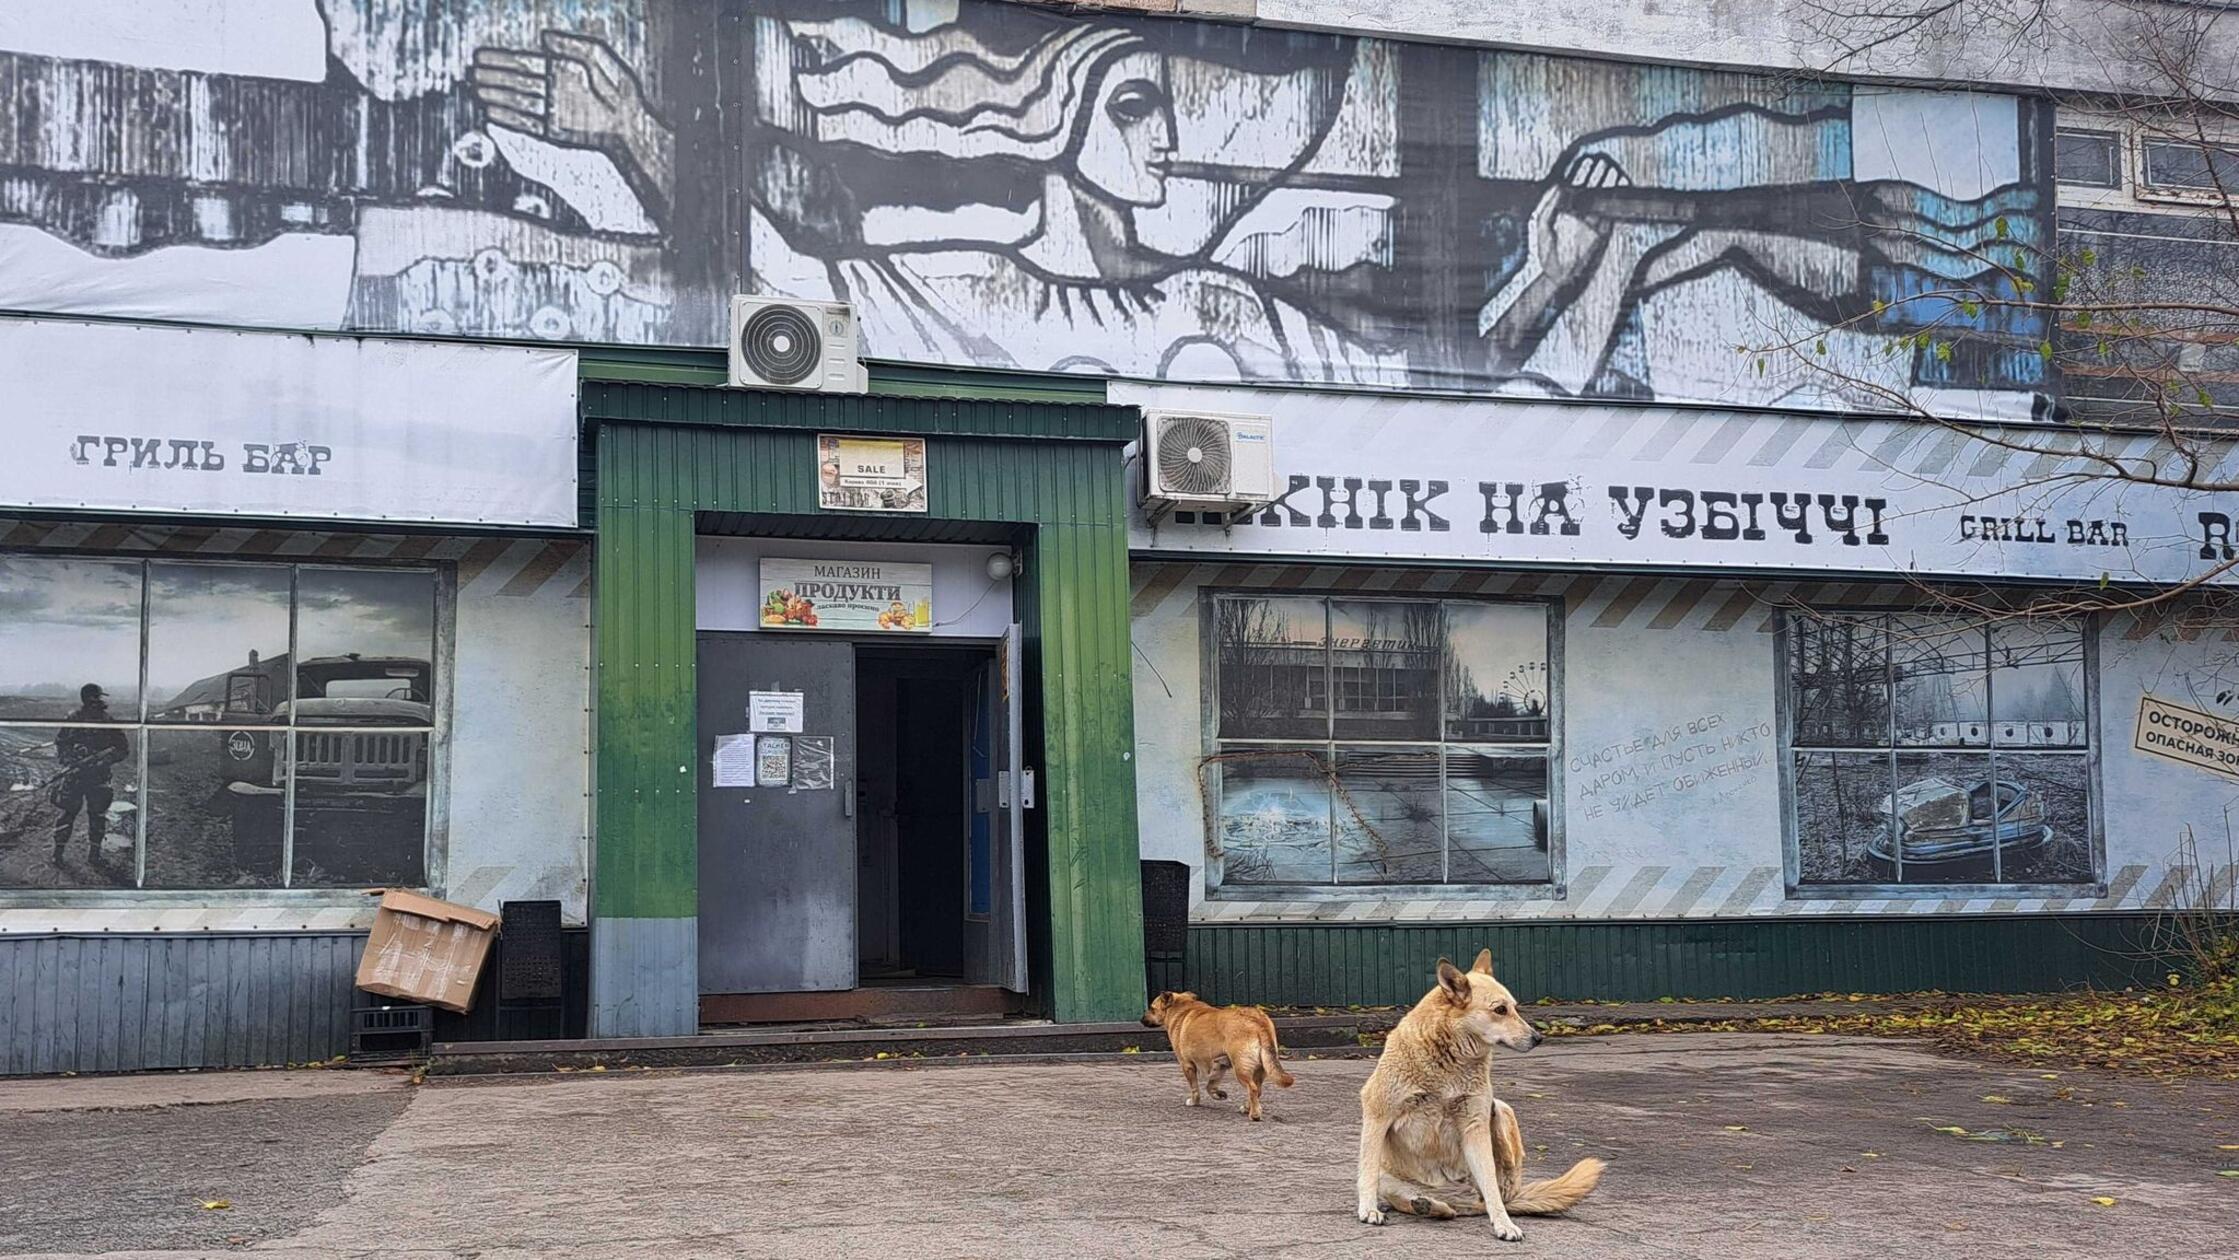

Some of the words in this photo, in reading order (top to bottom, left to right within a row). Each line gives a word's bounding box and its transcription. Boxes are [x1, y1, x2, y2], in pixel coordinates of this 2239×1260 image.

[76, 435, 225, 471] ГРИЛЬ
[242, 443, 332, 475] БАР
[857, 465, 886, 473] SALE
[1175, 474, 1450, 531] КНІК
[1478, 480, 1581, 536] НА
[1608, 486, 1889, 545] УЗБІЧЧІ
[1960, 515, 2056, 543] GRILL
[2066, 519, 2129, 546] BAR
[2198, 511, 2239, 560] R
[814, 565, 882, 580] МАГАЗИН
[794, 582, 902, 602] ПРОДУКТИ
[1570, 738, 1645, 773] СЧАСТЬЕ
[1652, 727, 1681, 750] ДЛЯ
[1687, 712, 1728, 735] ВСЕХ
[1661, 744, 1716, 771] ПУСТЬ
[1721, 722, 1771, 751] НИКТО
[2146, 731, 2214, 759] ОПАСНАЯ
[1584, 804, 1604, 821] НЕ
